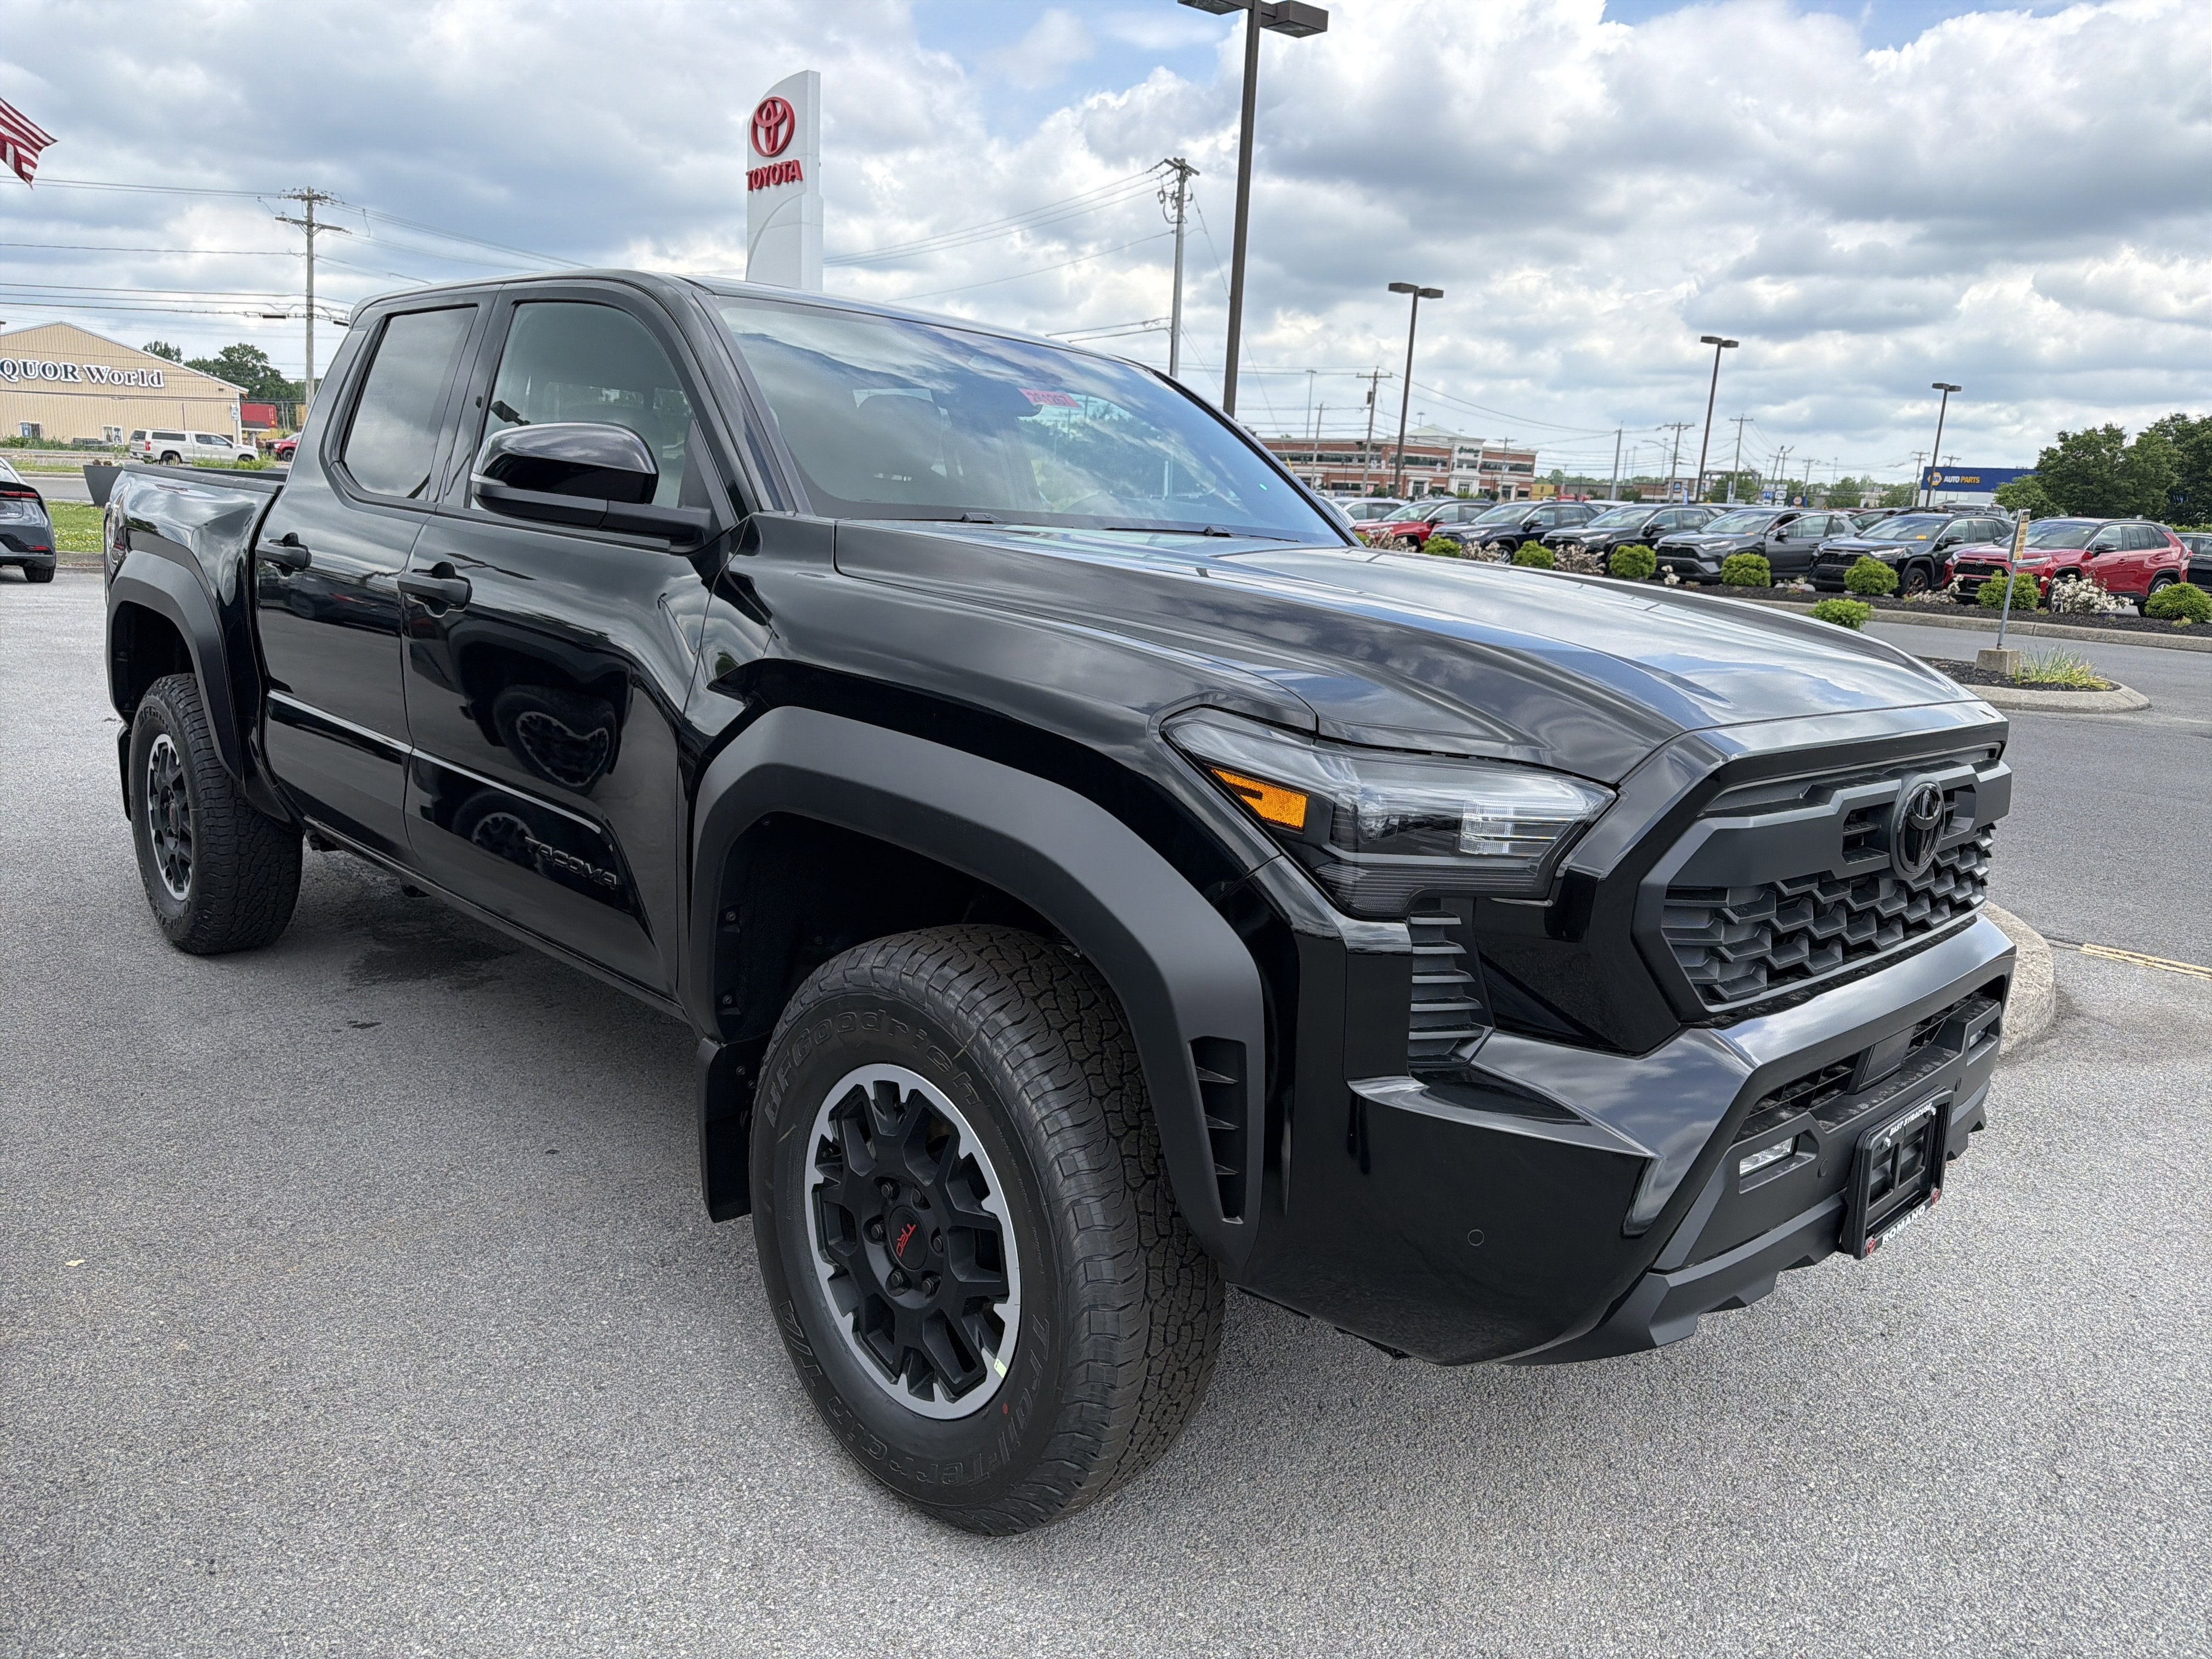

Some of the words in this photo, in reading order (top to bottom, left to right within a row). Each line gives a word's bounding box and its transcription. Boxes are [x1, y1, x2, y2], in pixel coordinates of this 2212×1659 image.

[746, 160, 803, 192] TOYOTA
[0, 358, 82, 382] QUOR
[83, 364, 164, 388] World
[525, 836, 618, 891] TACOMA
[764, 1009, 981, 1128] BFGoodrich
[1889, 1123, 1904, 1137] EAST
[1903, 1102, 1933, 1127] SYRACUSE
[896, 1223, 917, 1257] TRD
[1882, 1205, 1926, 1245] ROMANO
[778, 1299, 823, 1388] T/A
